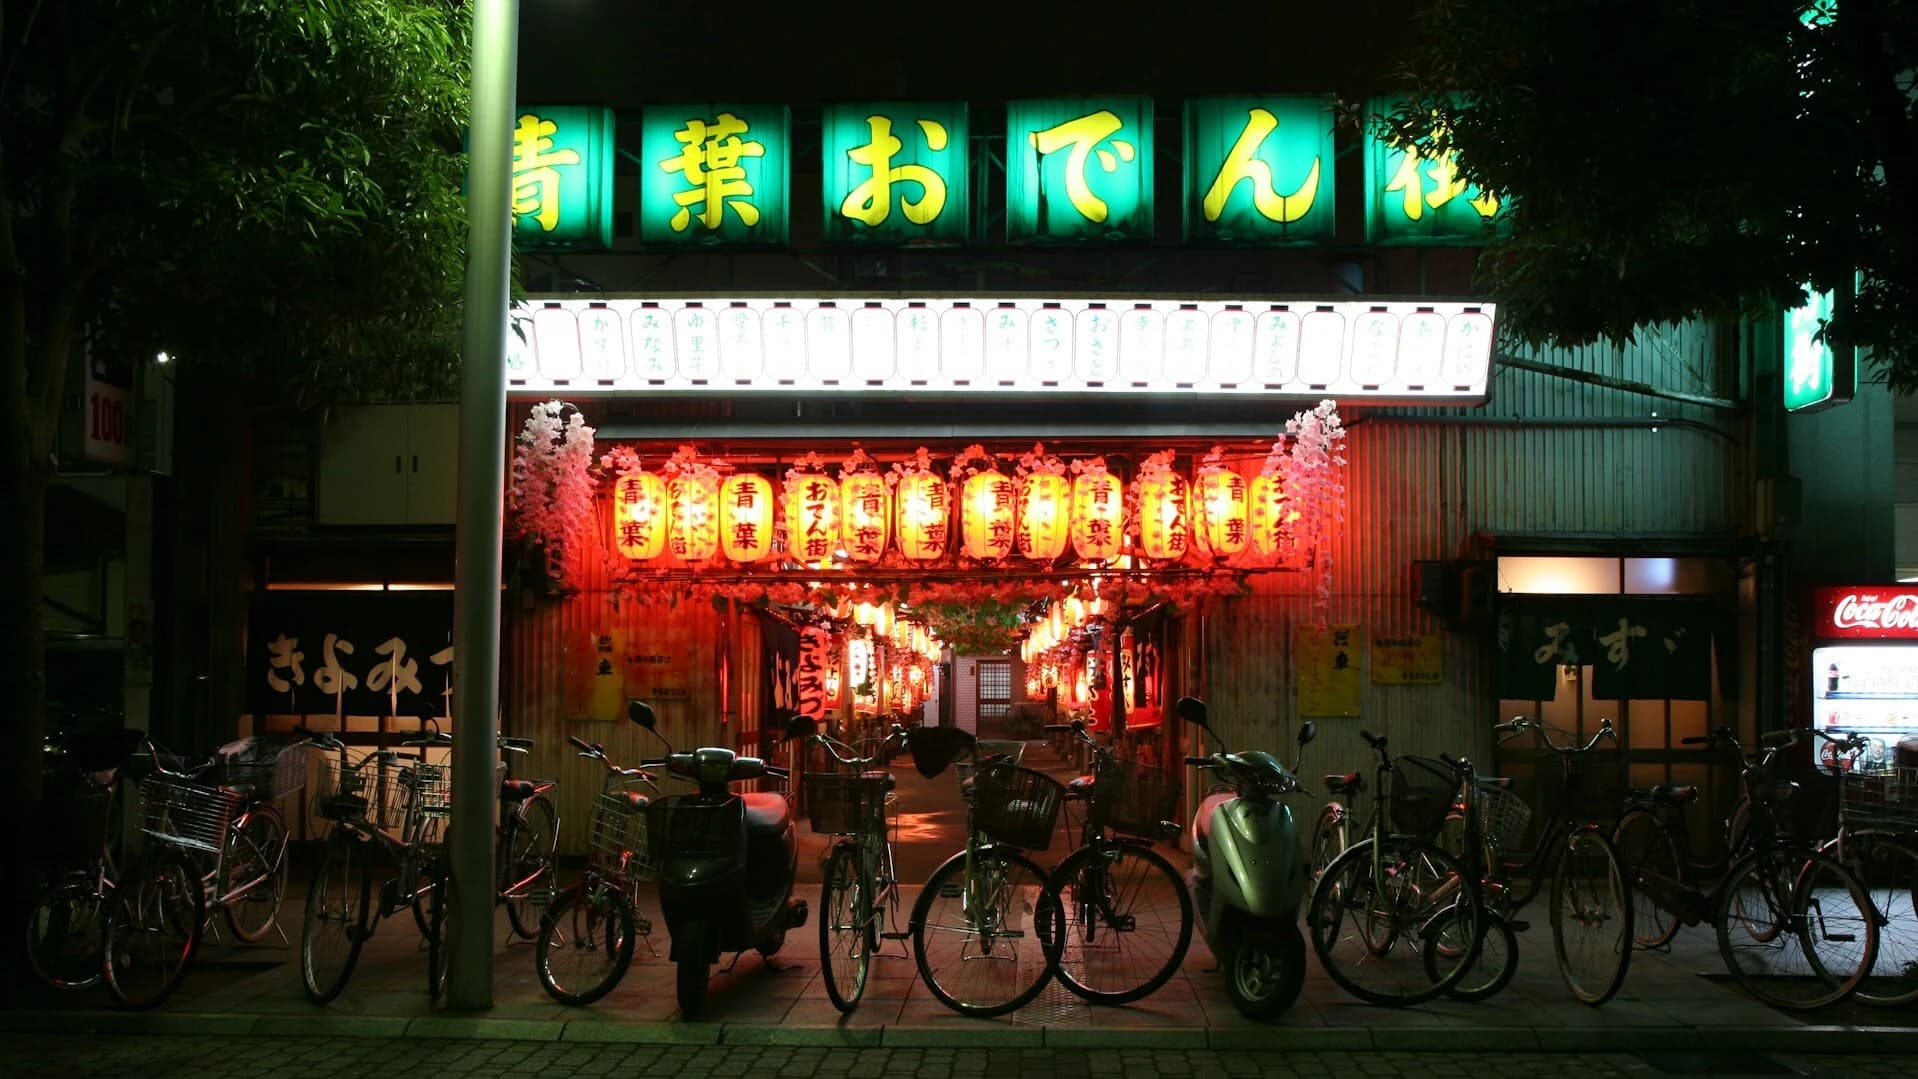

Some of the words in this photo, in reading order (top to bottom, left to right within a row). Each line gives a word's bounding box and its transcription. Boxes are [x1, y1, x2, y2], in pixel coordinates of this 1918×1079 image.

[620, 479, 648, 547] 青葉
[733, 481, 758, 550] 青葉
[856, 484, 882, 554] 青葉
[923, 482, 945, 552] 青葉
[987, 481, 1011, 549] 青葉
[1086, 480, 1113, 546] 青葉
[1225, 477, 1245, 545] 青葉
[1834, 594, 1918, 628] Coca-Col
